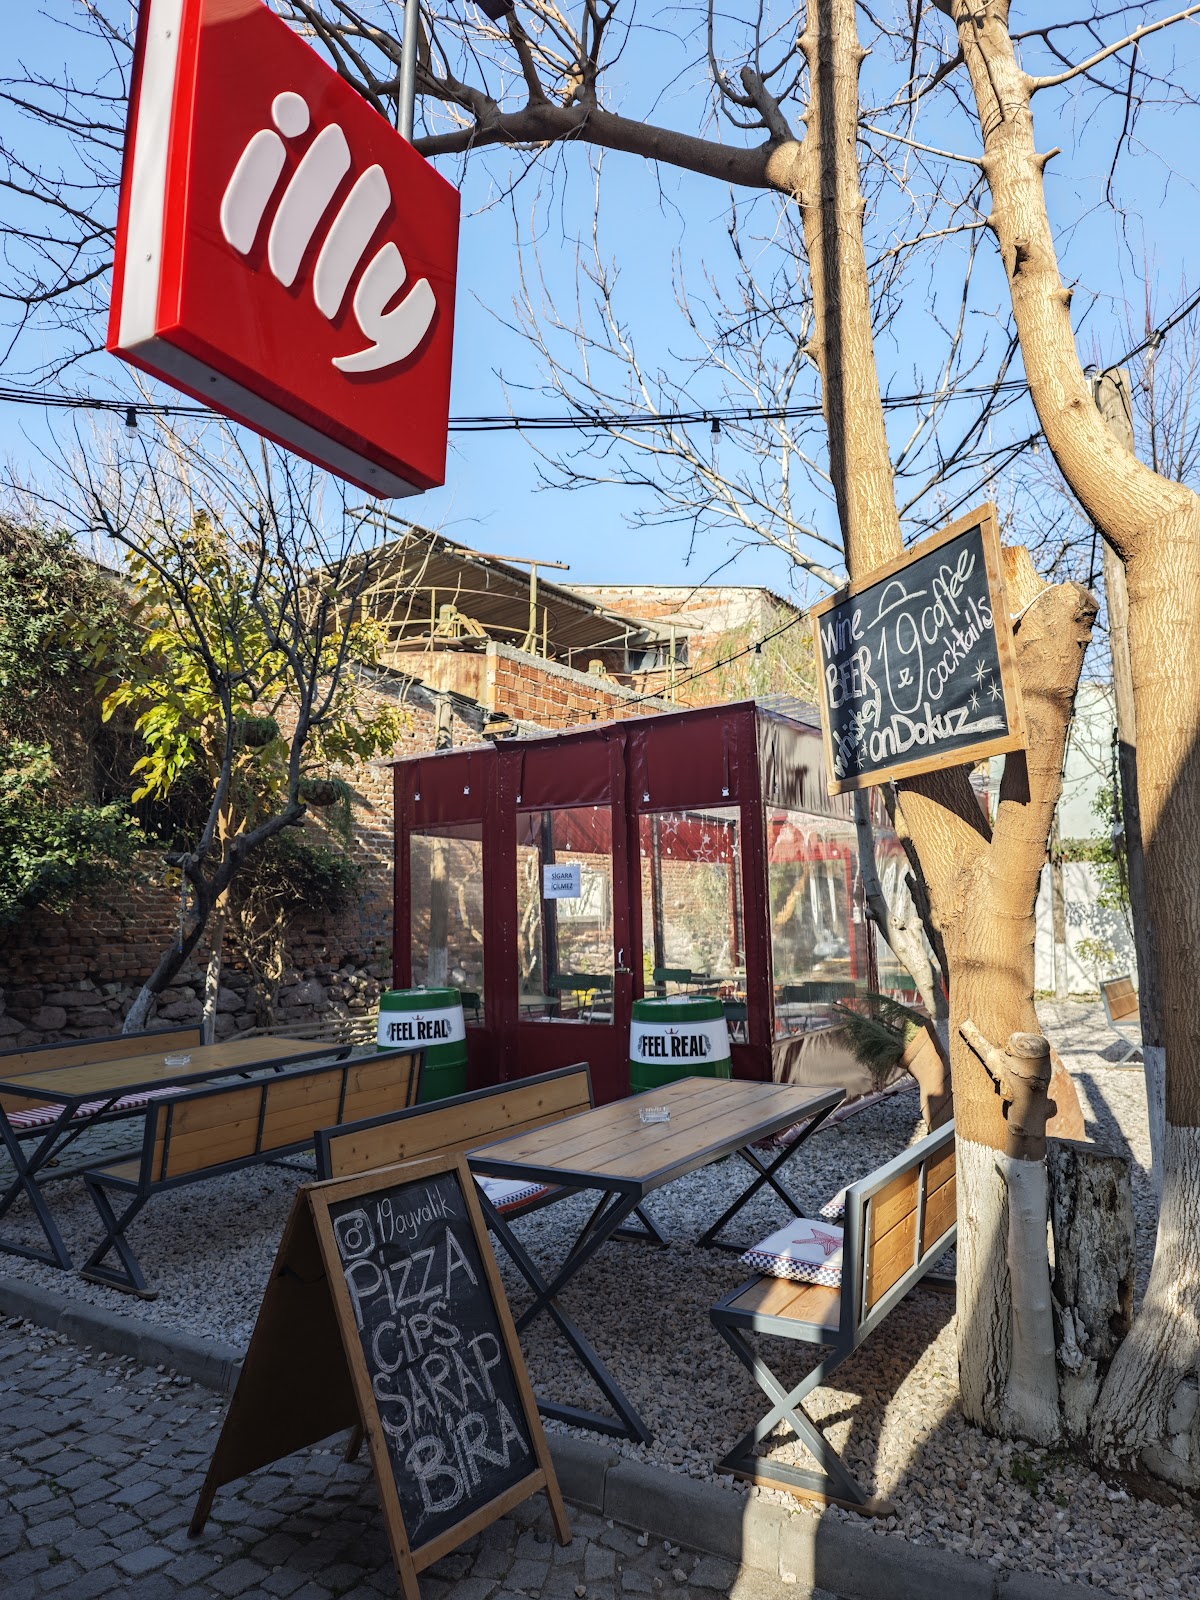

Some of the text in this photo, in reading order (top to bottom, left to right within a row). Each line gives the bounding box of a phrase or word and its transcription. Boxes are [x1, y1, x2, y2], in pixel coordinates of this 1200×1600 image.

[220, 91, 437, 373] illy
[820, 608, 865, 660] Wine
[825, 645, 878, 709] BEER
[390, 1020, 448, 1041] FEEL REAL
[642, 1035, 708, 1057] FEEL REAL
